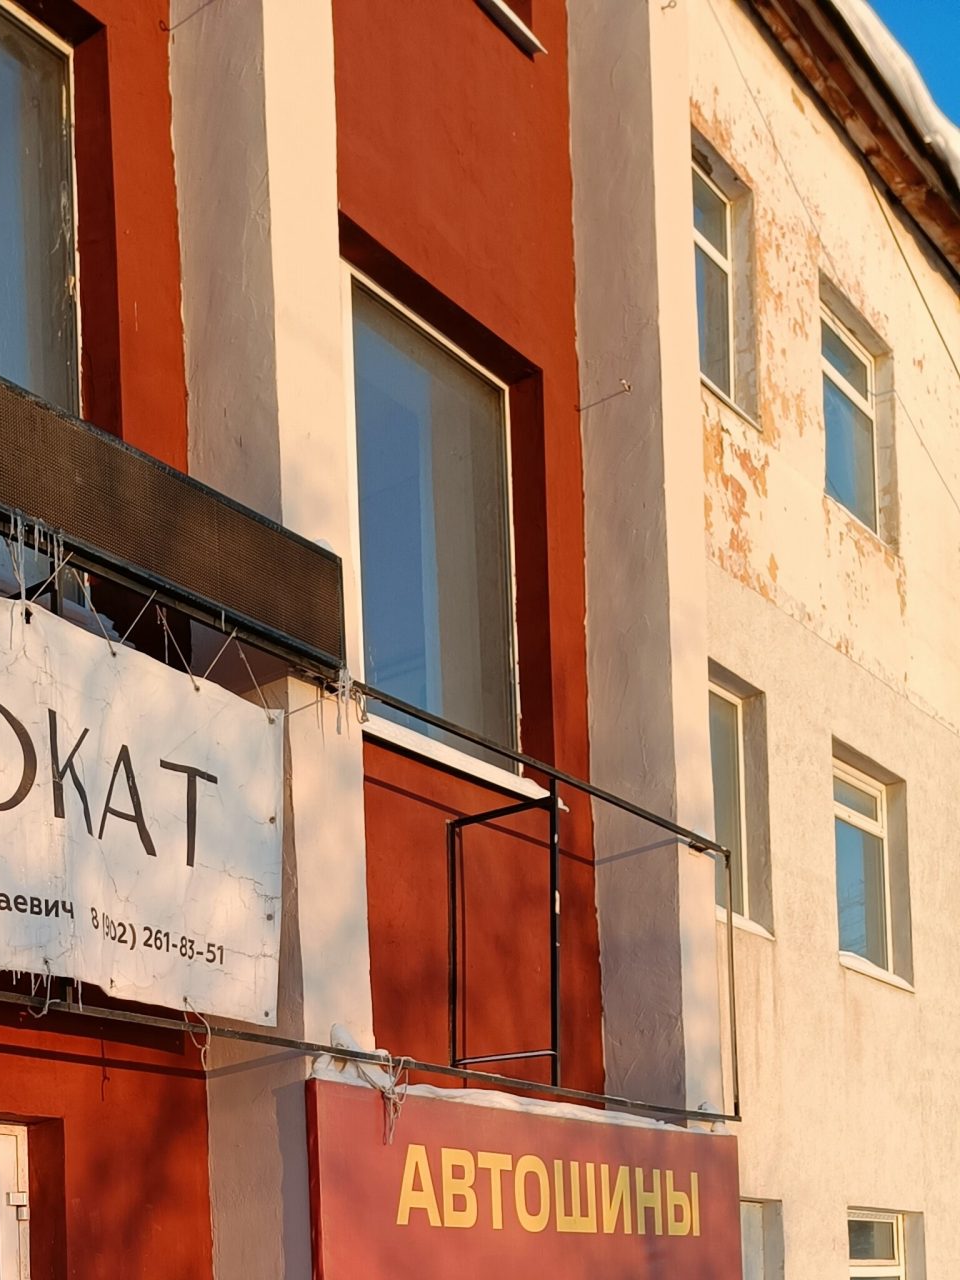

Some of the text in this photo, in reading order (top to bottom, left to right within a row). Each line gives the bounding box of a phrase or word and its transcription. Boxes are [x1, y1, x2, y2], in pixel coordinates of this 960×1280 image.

[90, 907, 100, 930] 8
[143, 926, 225, 965] 261-83-51
[396, 1143, 701, 1237] АВТОШИНЫ
